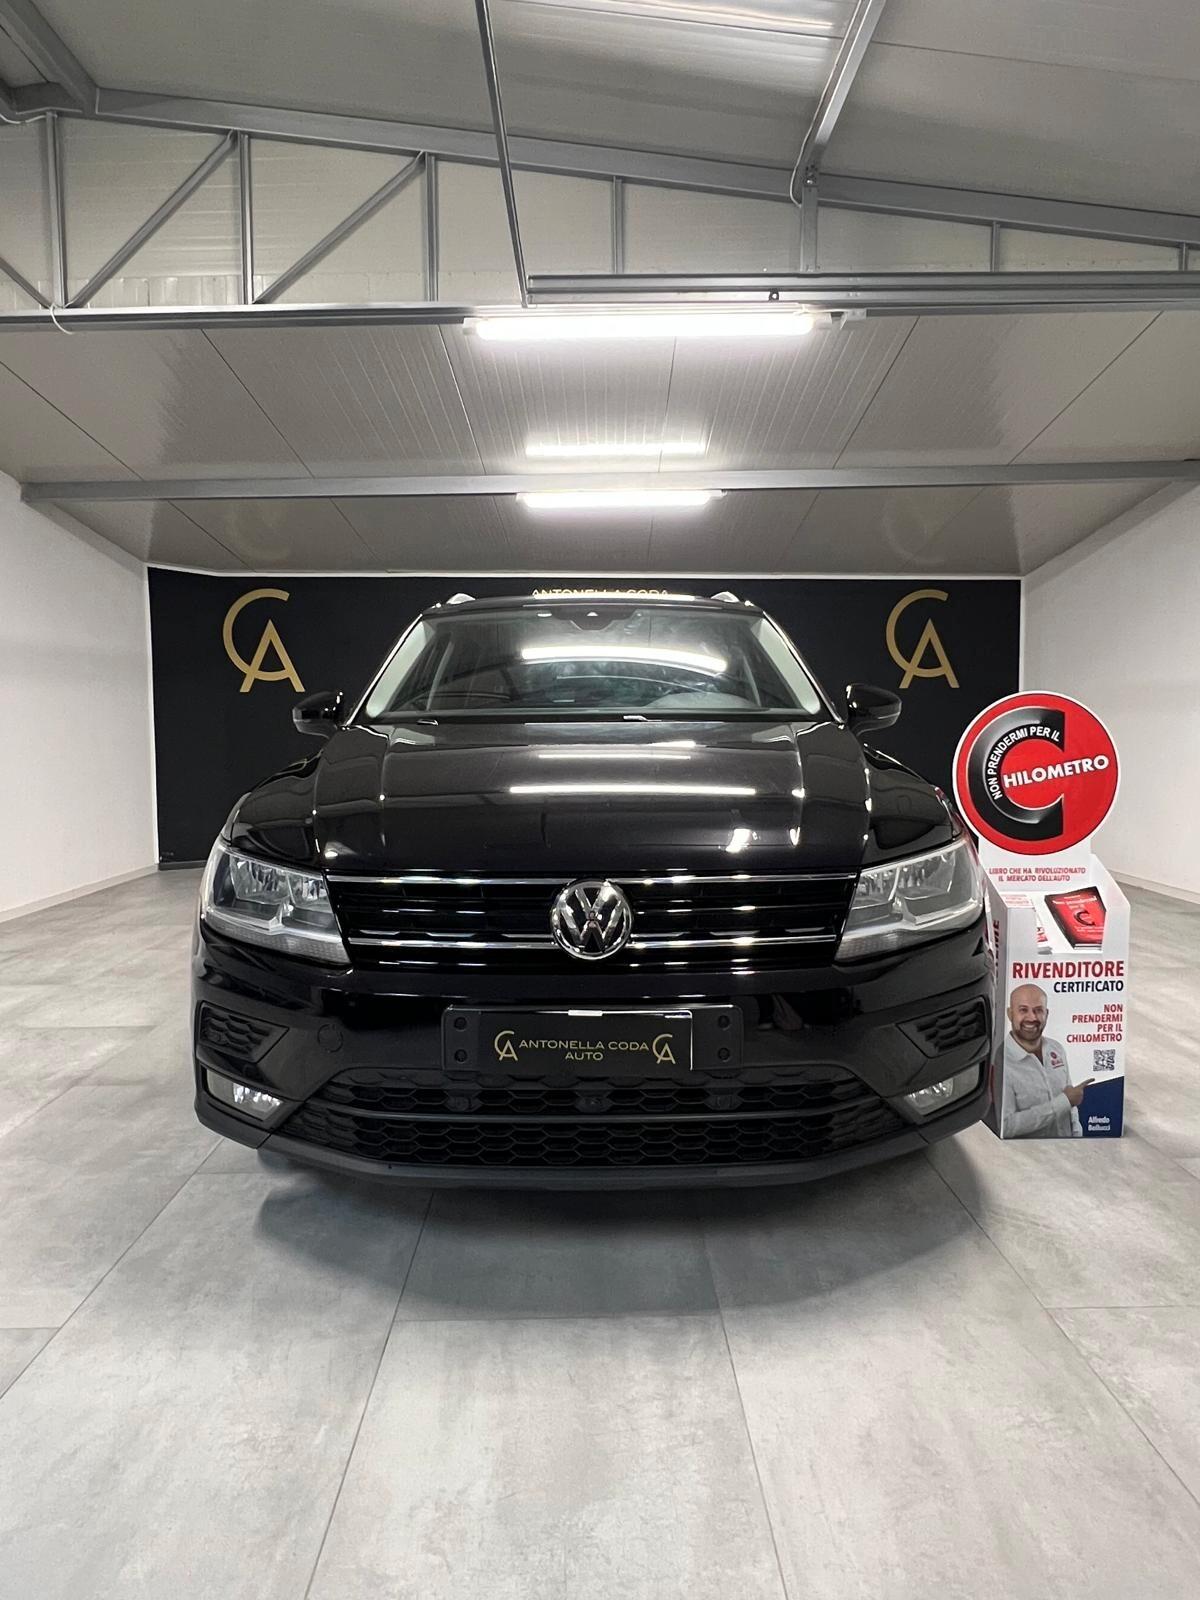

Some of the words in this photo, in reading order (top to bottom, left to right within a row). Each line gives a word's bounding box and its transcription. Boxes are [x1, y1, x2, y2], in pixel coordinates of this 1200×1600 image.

[1030, 726, 1050, 738] PER
[1051, 730, 1061, 742] IL
[987, 727, 1028, 776] PRENDERMI
[1003, 755, 1109, 788] HILOMETRO
[987, 777, 1003, 800] NON
[989, 867, 1008, 875] LIBRO
[1009, 867, 1021, 875] CHE
[552, 881, 631, 959] VW
[1012, 961, 1124, 979] RIVENDITORE
[1053, 980, 1124, 993] CERTIFICATO
[1103, 1004, 1123, 1013] NON
[1072, 1014, 1123, 1023] PRENDERMI
[1097, 1023, 1113, 1032] PER
[1115, 1023, 1123, 1032] IL
[1066, 1033, 1123, 1043] CHILOMETRO
[519, 1039, 604, 1050] ANTONELLA
[608, 1041, 649, 1051] CODA
[565, 1051, 604, 1060] AUTO
